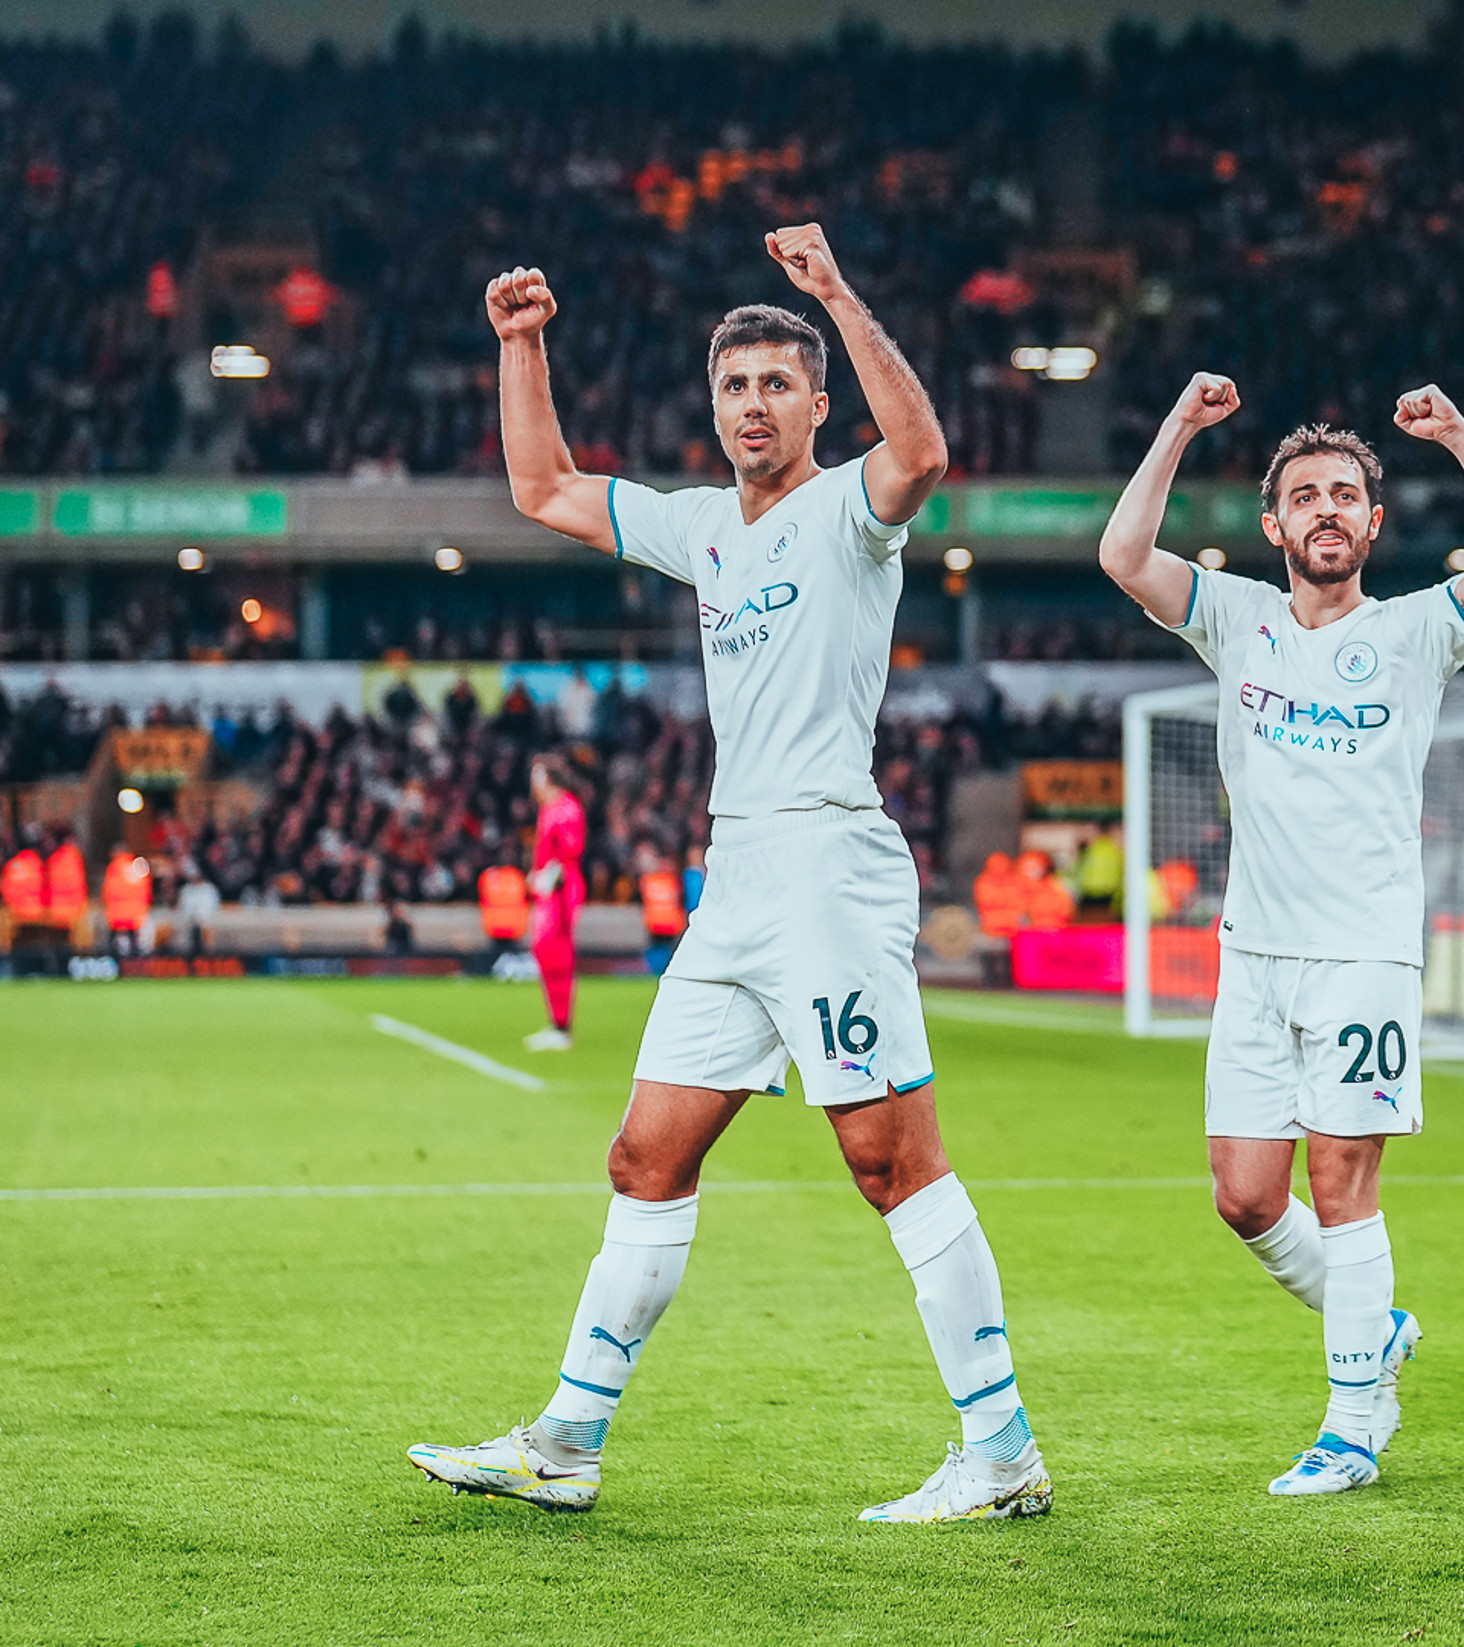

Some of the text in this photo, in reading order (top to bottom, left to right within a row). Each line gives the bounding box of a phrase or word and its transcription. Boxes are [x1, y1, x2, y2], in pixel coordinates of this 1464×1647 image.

[711, 624, 770, 657] AIWAYS
[1240, 682, 1391, 730] ETIHAD
[1253, 721, 1358, 755] AIRWAYS
[812, 989, 879, 1060] 16
[1338, 1020, 1406, 1083] 20
[1332, 1352, 1375, 1364] CITY
